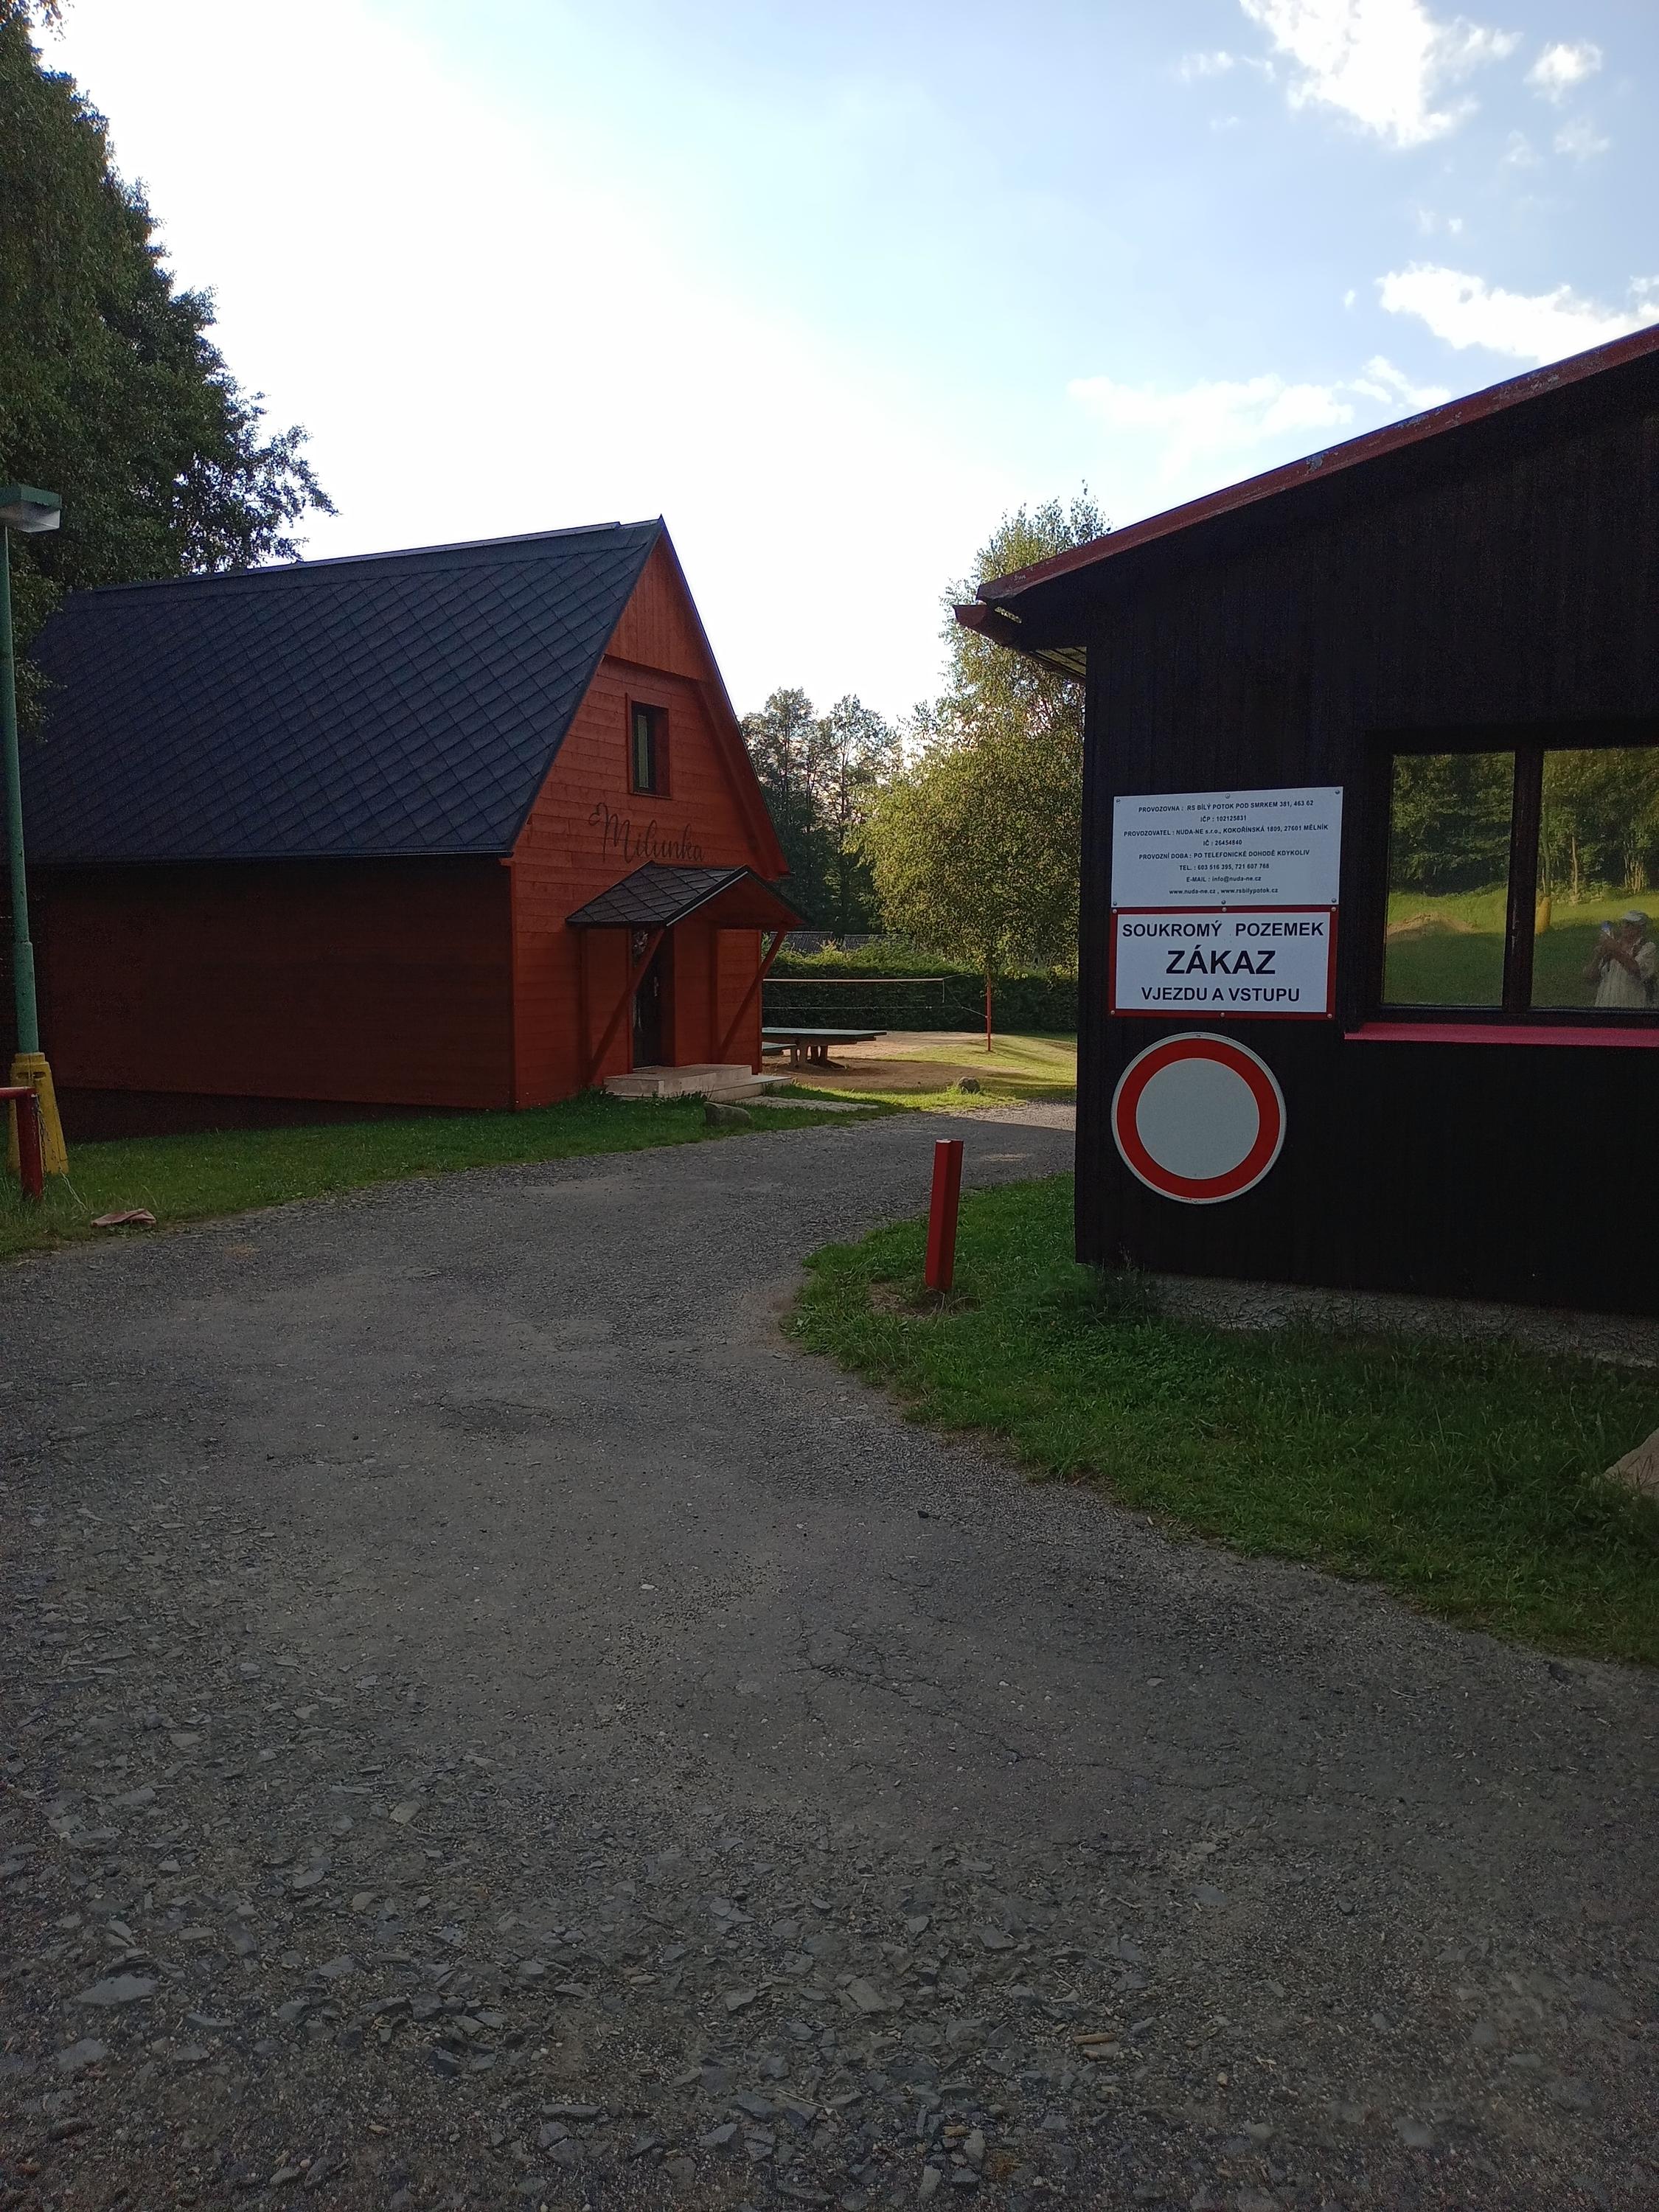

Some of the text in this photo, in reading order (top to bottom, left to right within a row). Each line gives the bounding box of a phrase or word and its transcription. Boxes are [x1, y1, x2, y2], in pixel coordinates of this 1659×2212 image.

[589, 802, 705, 863] Milunka
[1223, 825, 1265, 833] KOKOŘÍNSKÁ
[1205, 850, 1246, 858] TELEFONICKÉ
[1122, 920, 1324, 937] SOUKROMÝ POZEMEK
[1166, 945, 1276, 975] ZÁKAZ
[1141, 987, 1300, 1002] VJEZDU A VSTUPU
